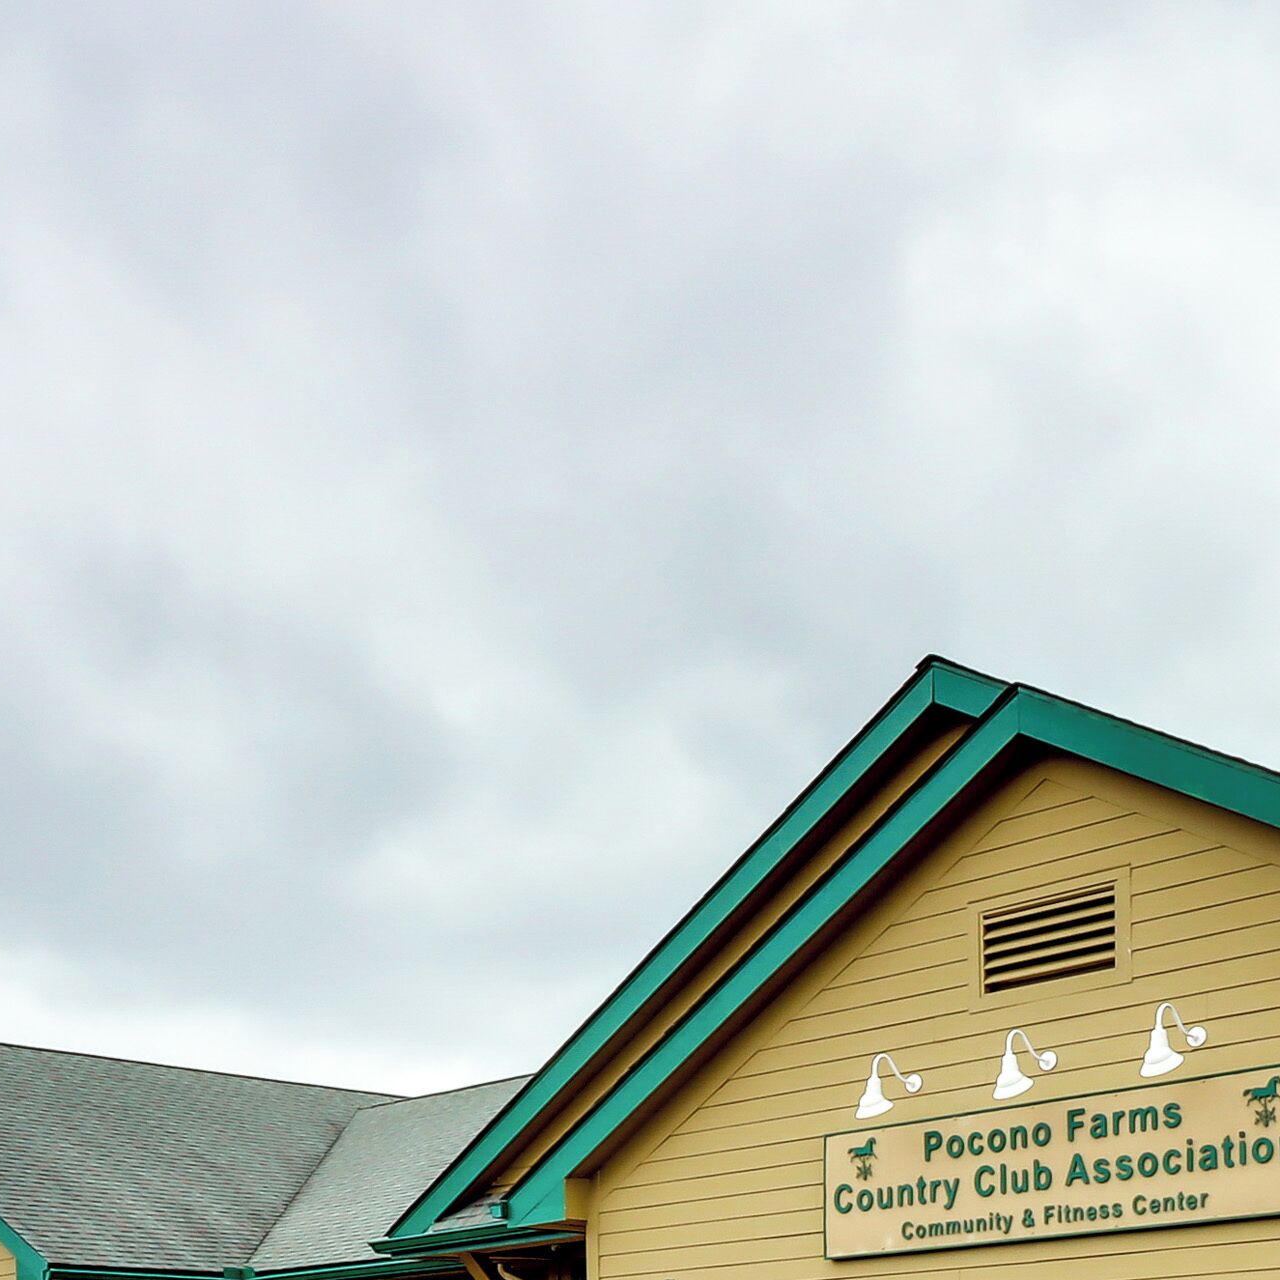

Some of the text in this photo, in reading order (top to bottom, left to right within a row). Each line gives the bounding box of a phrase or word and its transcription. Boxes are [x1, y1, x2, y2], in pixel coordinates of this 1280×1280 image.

[924, 1102, 1183, 1162] Pocono Farms
[833, 1176, 960, 1214] Country
[974, 1159, 1052, 1197] Club
[901, 1192, 1209, 1241] Community & Fitness Center
